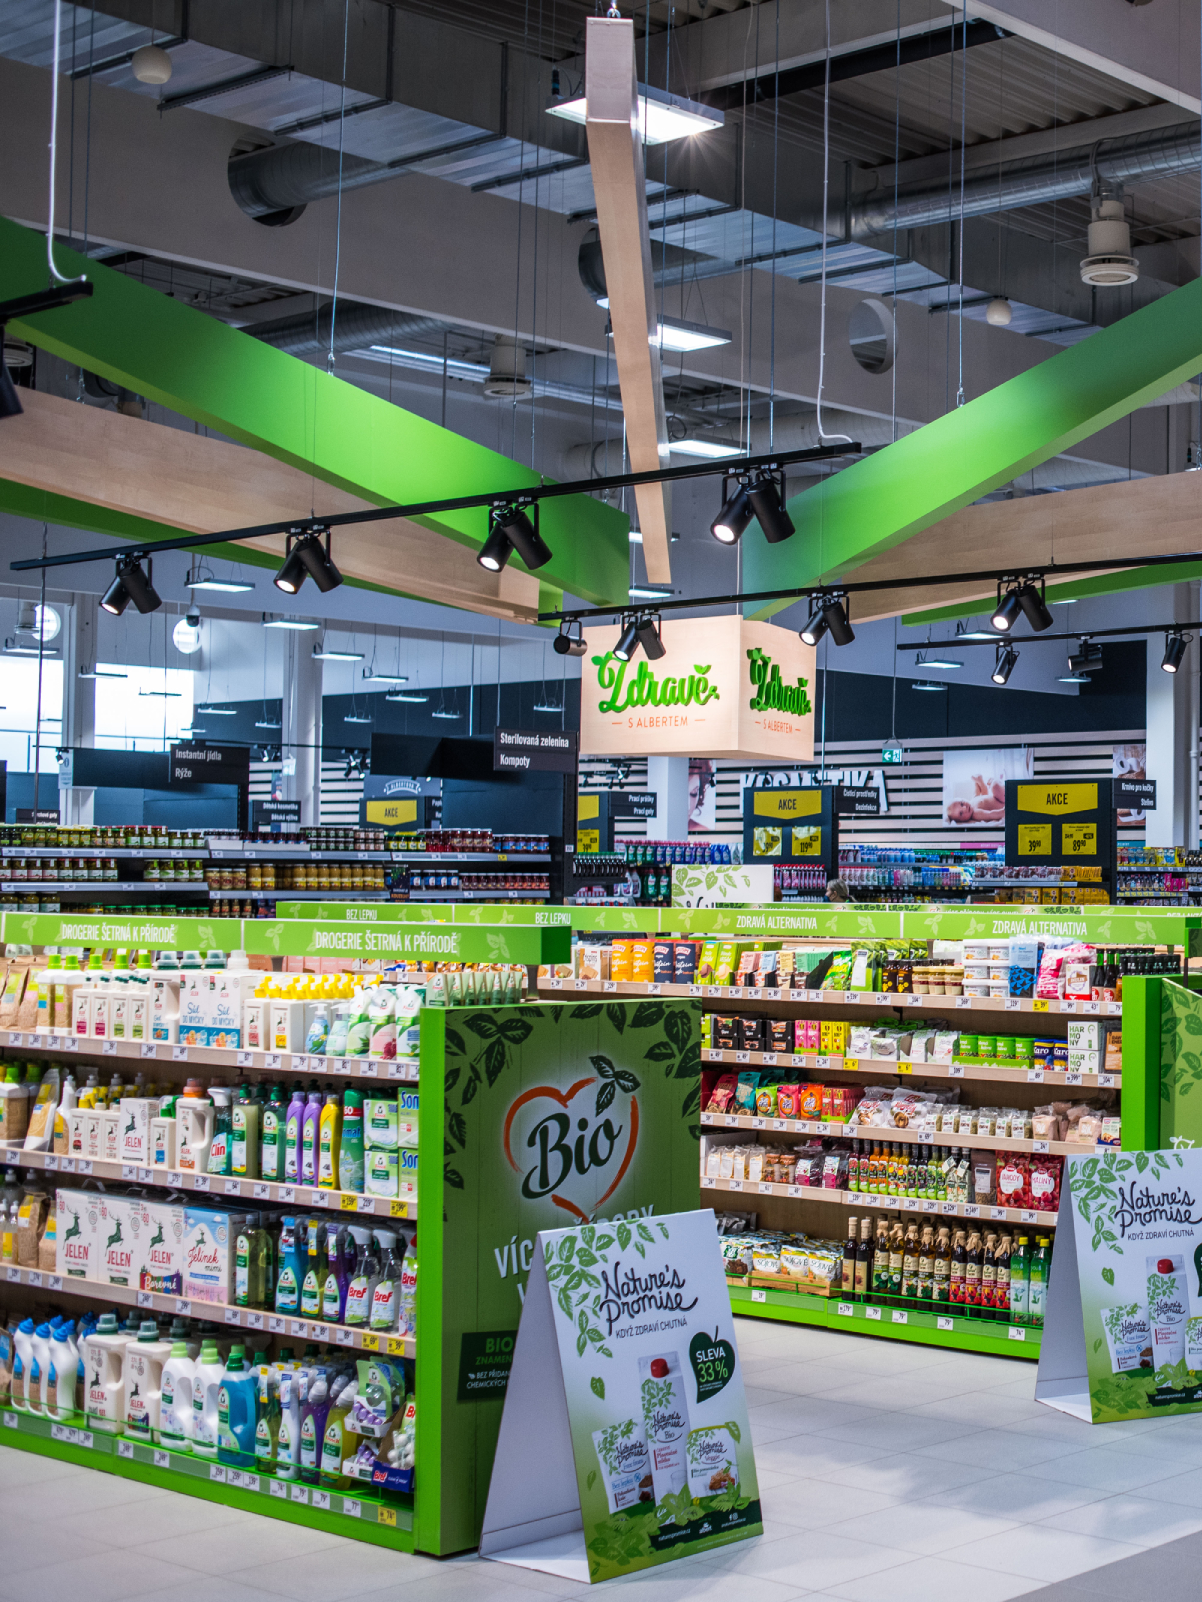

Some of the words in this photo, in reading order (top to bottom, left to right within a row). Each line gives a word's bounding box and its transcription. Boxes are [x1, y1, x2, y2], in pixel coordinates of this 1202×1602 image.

[591, 650, 720, 714] Zdravě
[747, 647, 812, 716] Zdravě
[628, 718, 634, 728] S
[636, 716, 688, 728] ALBERTEM
[768, 720, 793, 734] ALBERTEM
[500, 733, 539, 746] Sterilovaná
[540, 736, 569, 748] zelenina
[176, 749, 206, 760] Instantní
[207, 750, 222, 762] jídla
[500, 754, 530, 769] Kompoty
[175, 767, 192, 780] Rýže
[778, 799, 797, 810] AKCE
[1046, 792, 1068, 805] AKCE
[384, 807, 398, 818] AKCE
[346, 909, 358, 920] BEZ
[359, 909, 378, 921] LEPKU
[535, 912, 550, 924] BEZ
[551, 912, 571, 925] LEPKU
[736, 914, 765, 930] ZDRAVÁ
[767, 916, 818, 930] ALTERNATIVA
[62, 923, 100, 941] DROGERIE
[101, 922, 131, 942] ŠETRNÁ
[132, 927, 139, 942] K
[140, 923, 176, 943] PŘÍRODĚ
[992, 918, 1027, 934] ZDRAVÁ
[1029, 920, 1088, 937] ALTERNATIVA
[316, 931, 363, 950] DROGERIE
[365, 930, 403, 951] ŠETRNÁ
[404, 937, 413, 951] K
[414, 930, 458, 953] PŘÍRODĚ
[1069, 1025, 1085, 1033] HAR
[1070, 1053, 1086, 1061] HAR
[124, 1136, 142, 1149] JELEN
[211, 1143, 226, 1157] Clin
[522, 1112, 623, 1199] Bio
[1119, 1181, 1195, 1211] Nature's
[1127, 1230, 1145, 1241] KDYŽ
[1145, 1229, 1168, 1240] ZDRAVÍ
[1169, 1228, 1194, 1238] CHUTNÁ
[64, 1243, 89, 1260] JELEN
[150, 1250, 171, 1265] JELEN
[188, 1247, 220, 1266] Jelínek
[494, 1235, 533, 1279] VÍC
[107, 1250, 131, 1268] JELEN
[204, 1264, 222, 1273] mimi
[144, 1276, 178, 1290] Barevné
[601, 1261, 686, 1301] Nature's
[348, 1287, 367, 1298] Bref
[374, 1291, 393, 1303] Bref
[600, 1290, 699, 1337] Promise
[616, 1326, 634, 1339] KDYŽ
[634, 1321, 659, 1335] ZDRAVÍ
[660, 1316, 688, 1332] CHUTNÁ
[486, 1337, 514, 1354] BIO
[475, 1353, 512, 1366] ZNAMEN
[695, 1347, 726, 1363] SLEVA
[476, 1370, 488, 1379] BEZ
[488, 1369, 510, 1378] PŘIDAN
[466, 1378, 506, 1390] CHEMICKÝCH
